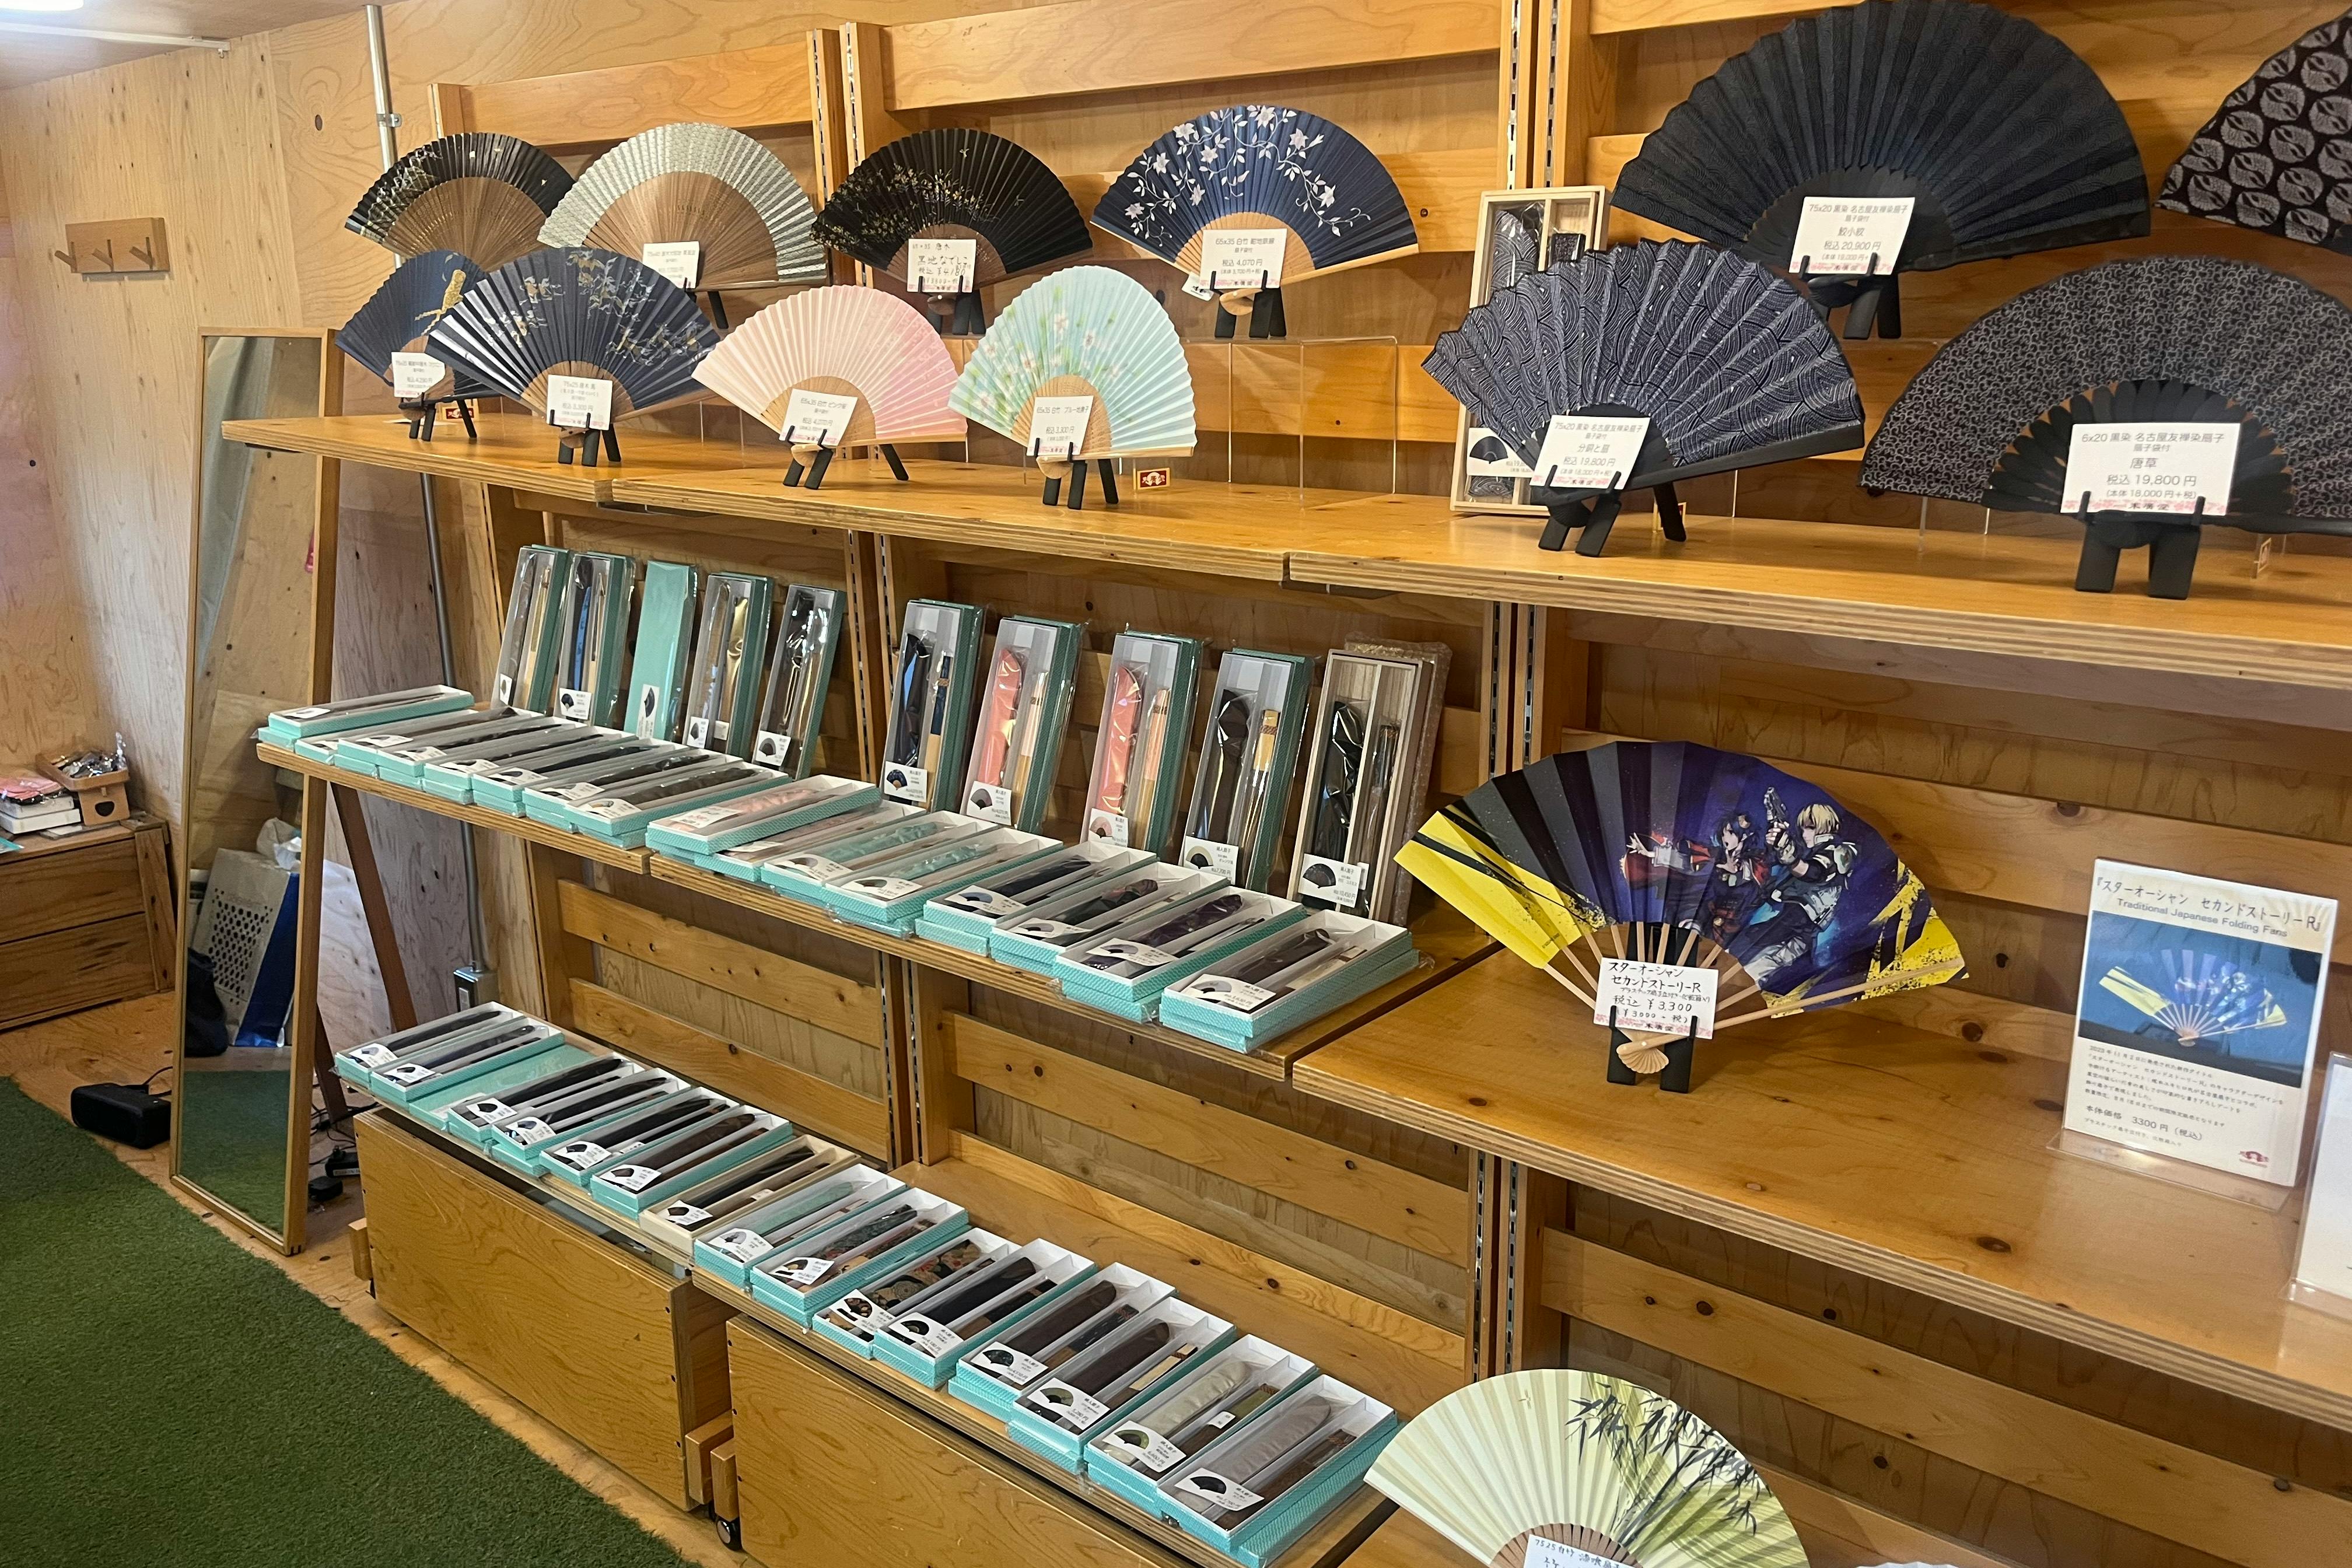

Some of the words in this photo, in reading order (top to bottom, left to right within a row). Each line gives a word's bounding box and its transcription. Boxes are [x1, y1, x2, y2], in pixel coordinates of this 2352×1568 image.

[2130, 458, 2158, 468] 唐草
[2107, 474, 2130, 485] 税込
[2135, 475, 2180, 486] 19,800
[2183, 475, 2197, 487] 円
[2118, 898, 2167, 914] Traditional
[2171, 909, 2218, 924] Japanese
[2222, 917, 2259, 933] Folding
[2263, 925, 2287, 937] Fans
[1608, 962, 1684, 977] スターオーシャン
[1614, 995, 1641, 1006] 税込
[2132, 1116, 2157, 1129] 3300
